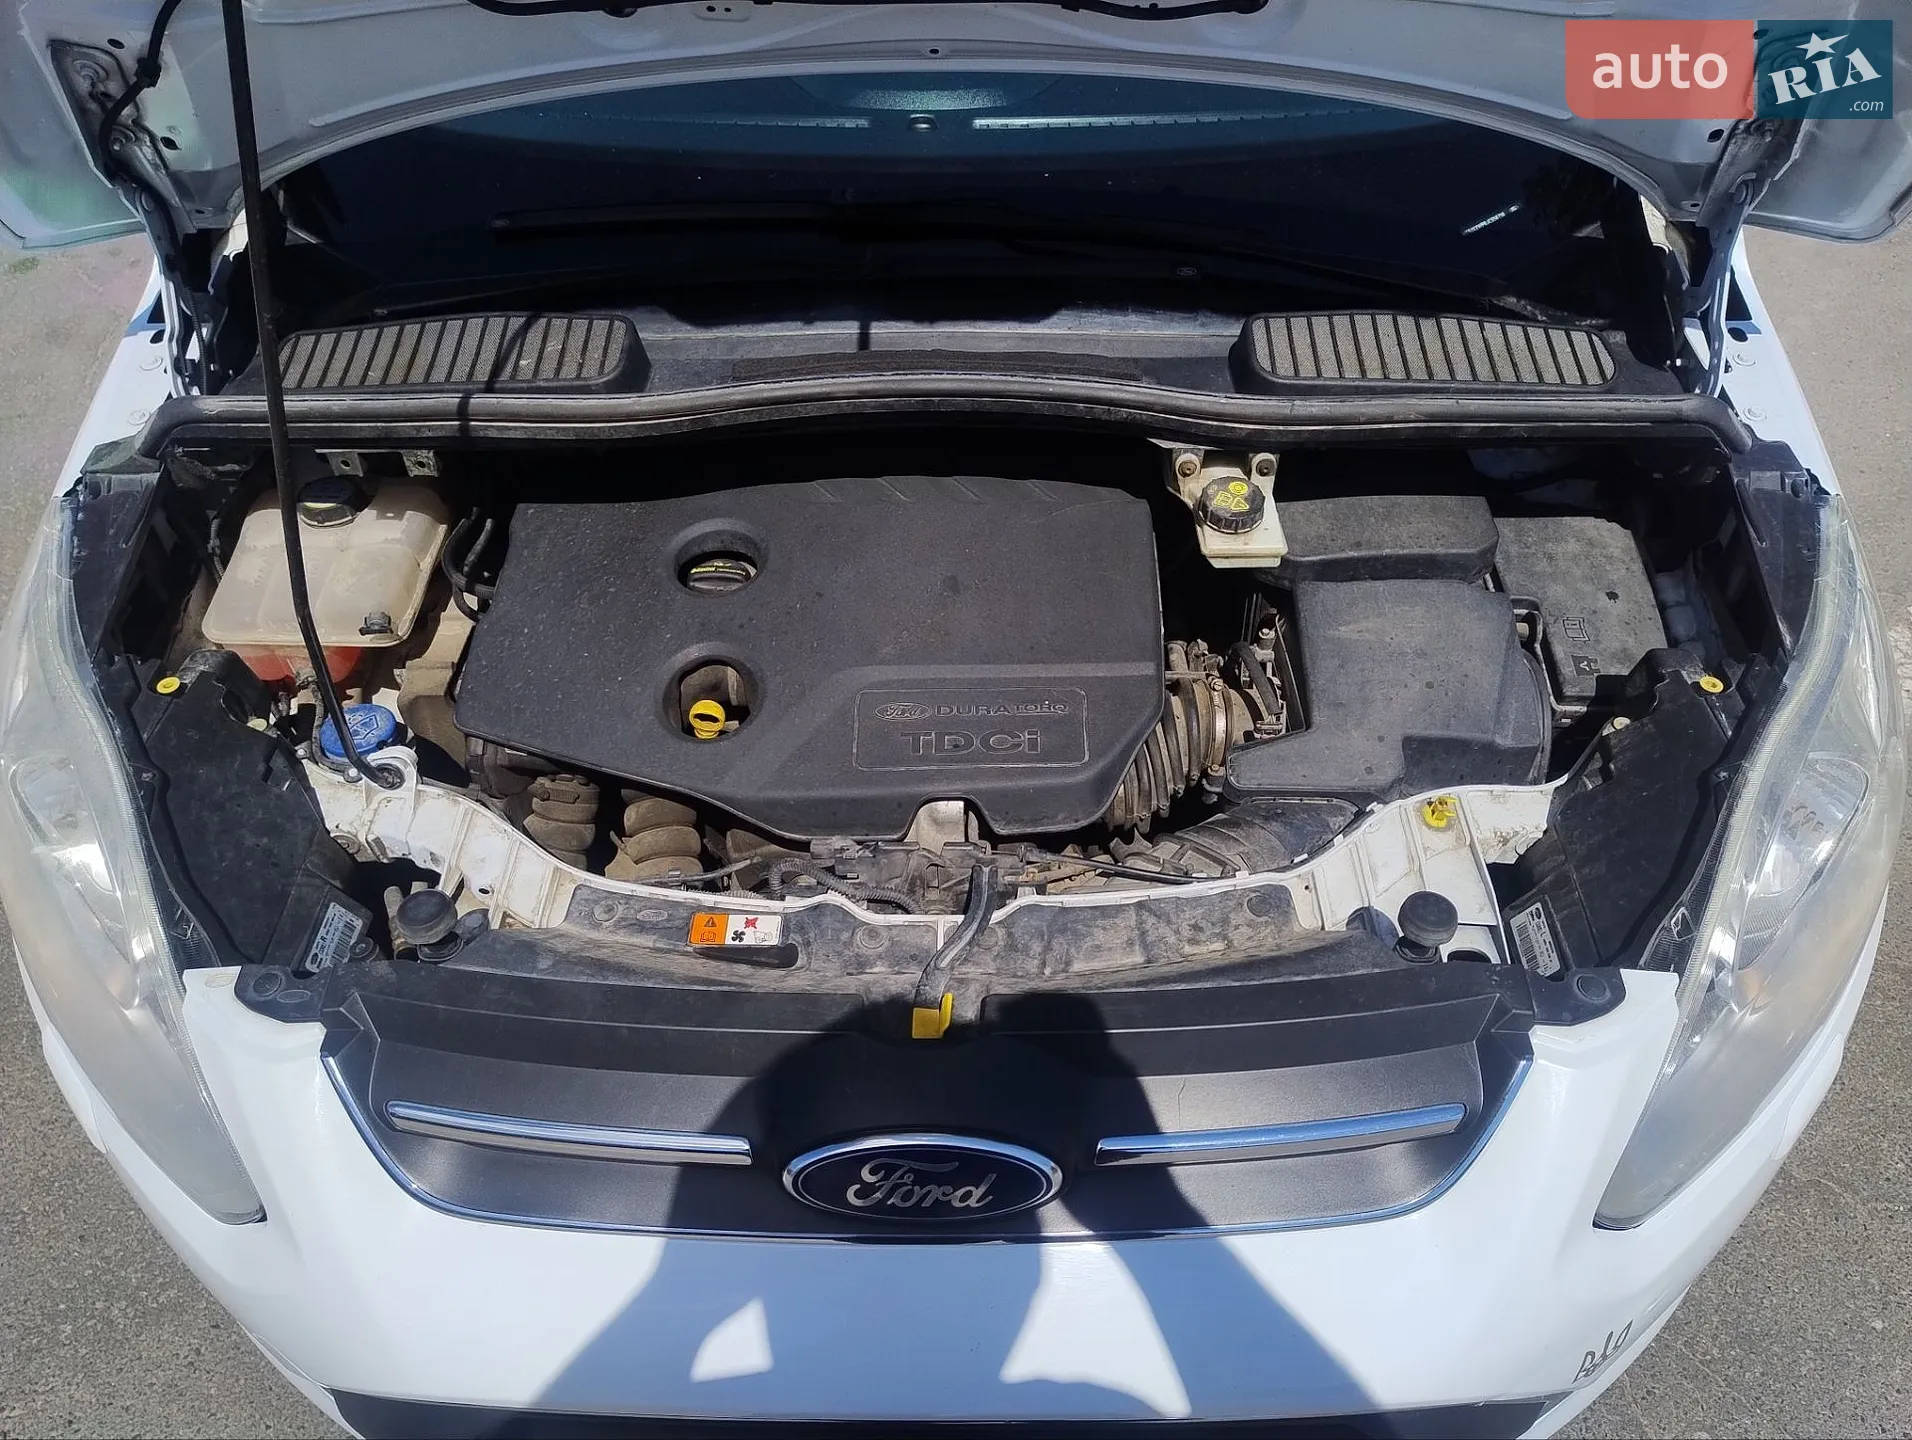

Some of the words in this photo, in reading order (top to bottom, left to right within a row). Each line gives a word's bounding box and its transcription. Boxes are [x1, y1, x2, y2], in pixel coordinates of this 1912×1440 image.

[884, 703, 922, 718] Ford
[901, 730, 1041, 755] TDCi
[846, 1158, 997, 1207] Ford
